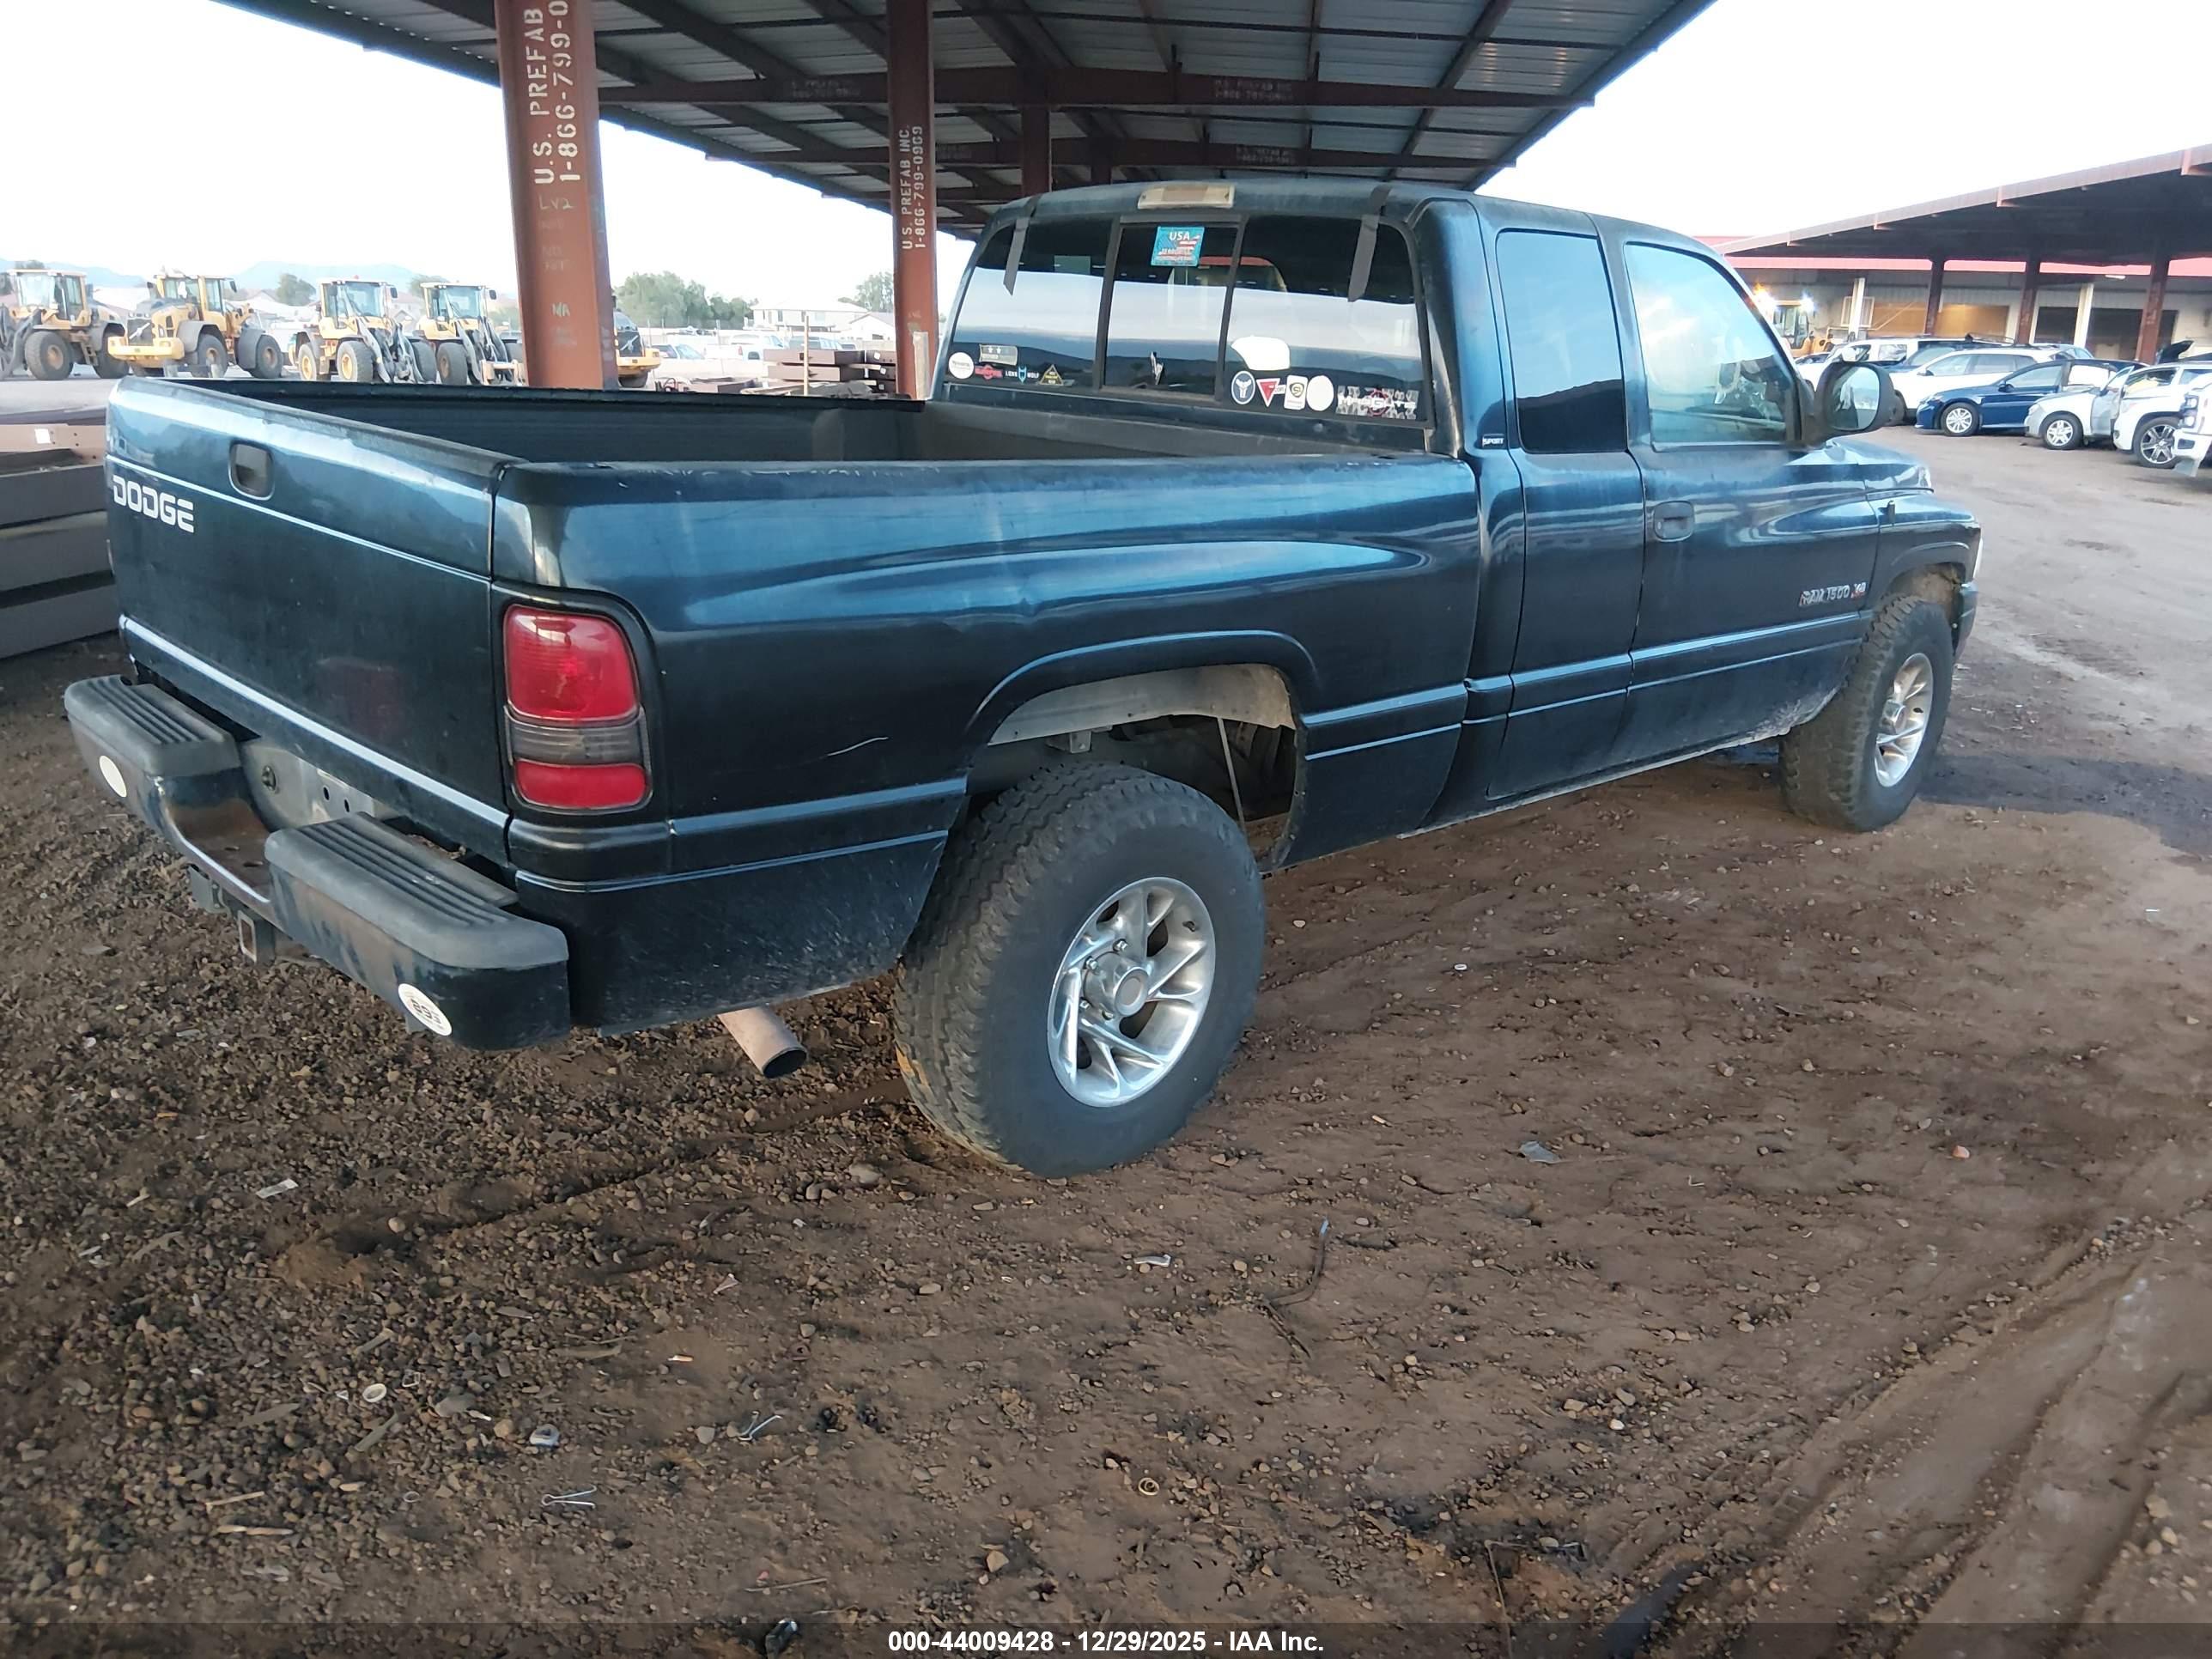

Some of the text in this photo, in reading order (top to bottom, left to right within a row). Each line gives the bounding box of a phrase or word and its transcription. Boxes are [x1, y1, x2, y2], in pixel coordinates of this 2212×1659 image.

[523, 8, 555, 185] U.S. PREFAB
[899, 159, 912, 216] PREFAB
[1169, 230, 1190, 241] USA
[112, 474, 194, 533] DODGE
[1826, 585, 1850, 600] 1500
